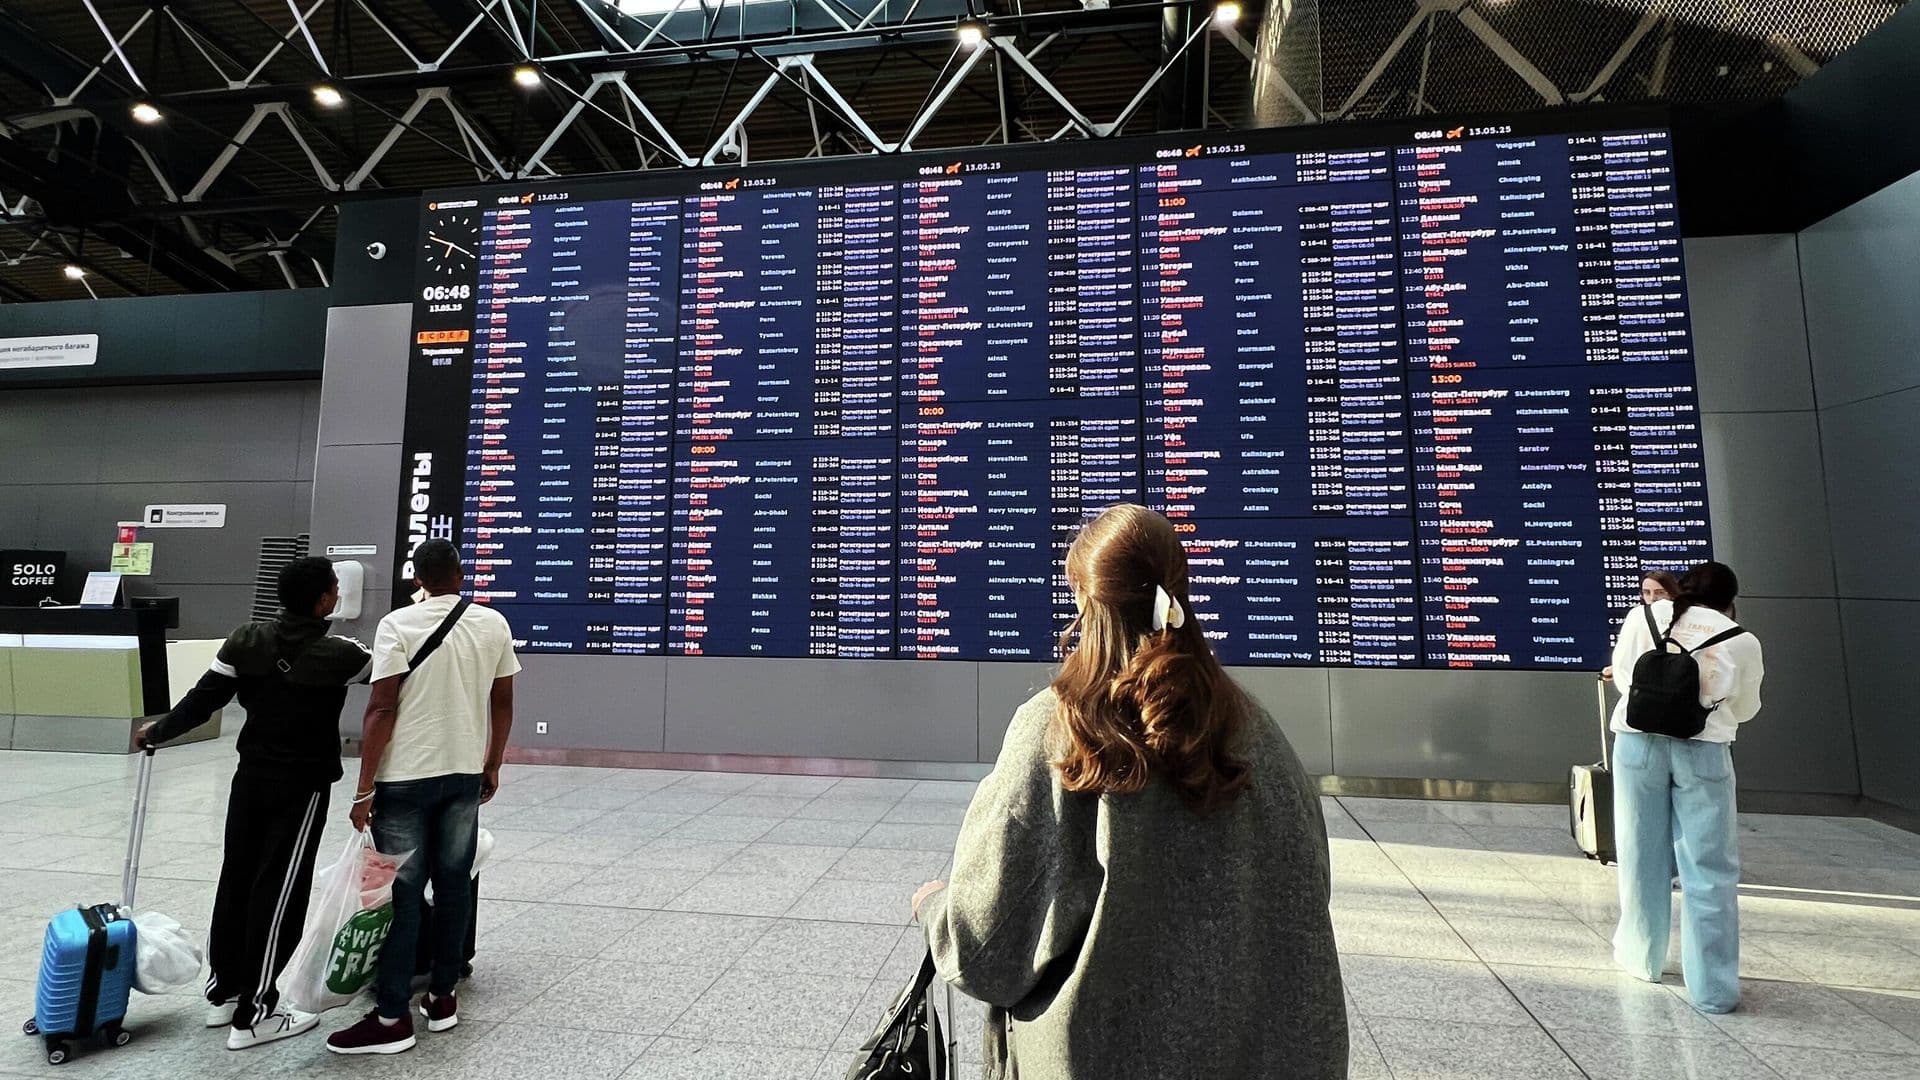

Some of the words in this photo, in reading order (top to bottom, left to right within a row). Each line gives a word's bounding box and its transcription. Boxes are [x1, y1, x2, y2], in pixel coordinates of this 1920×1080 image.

[1470, 126, 1511, 135] 13.05.25
[1207, 145, 1245, 154] 13.05.25
[966, 162, 1000, 171] 13.05.25
[744, 178, 776, 187] 13.05.25
[1159, 198, 1185, 206] 11:00
[1421, 229, 1496, 239] Санкт-Петербург
[423, 285, 470, 300] 06:48
[430, 304, 462, 312] 13.05.25
[988, 321, 1033, 329] St.Petersburg
[1432, 375, 1462, 383] 13:00
[1432, 389, 1508, 398] Санкт-Петербург
[1515, 389, 1570, 397] St.Petersburg
[919, 407, 944, 415] 10:00
[918, 421, 983, 429] Санкт-Петербург
[988, 421, 1034, 429] St.Petersburg
[1164, 433, 1181, 442] Уфа
[1241, 432, 1253, 440] Ufa
[1567, 463, 1587, 471] Vody
[755, 476, 798, 484] St.Petersburg
[918, 472, 937, 480] Сочи
[988, 472, 1006, 480] Sochi
[1523, 501, 1545, 509] Sochi
[988, 524, 1014, 532] Antalya
[917, 540, 983, 549] Санкт-Петербург
[13, 564, 56, 575] SOLO
[12, 577, 55, 585] COFFEE
[1532, 616, 1558, 624] Gomel
